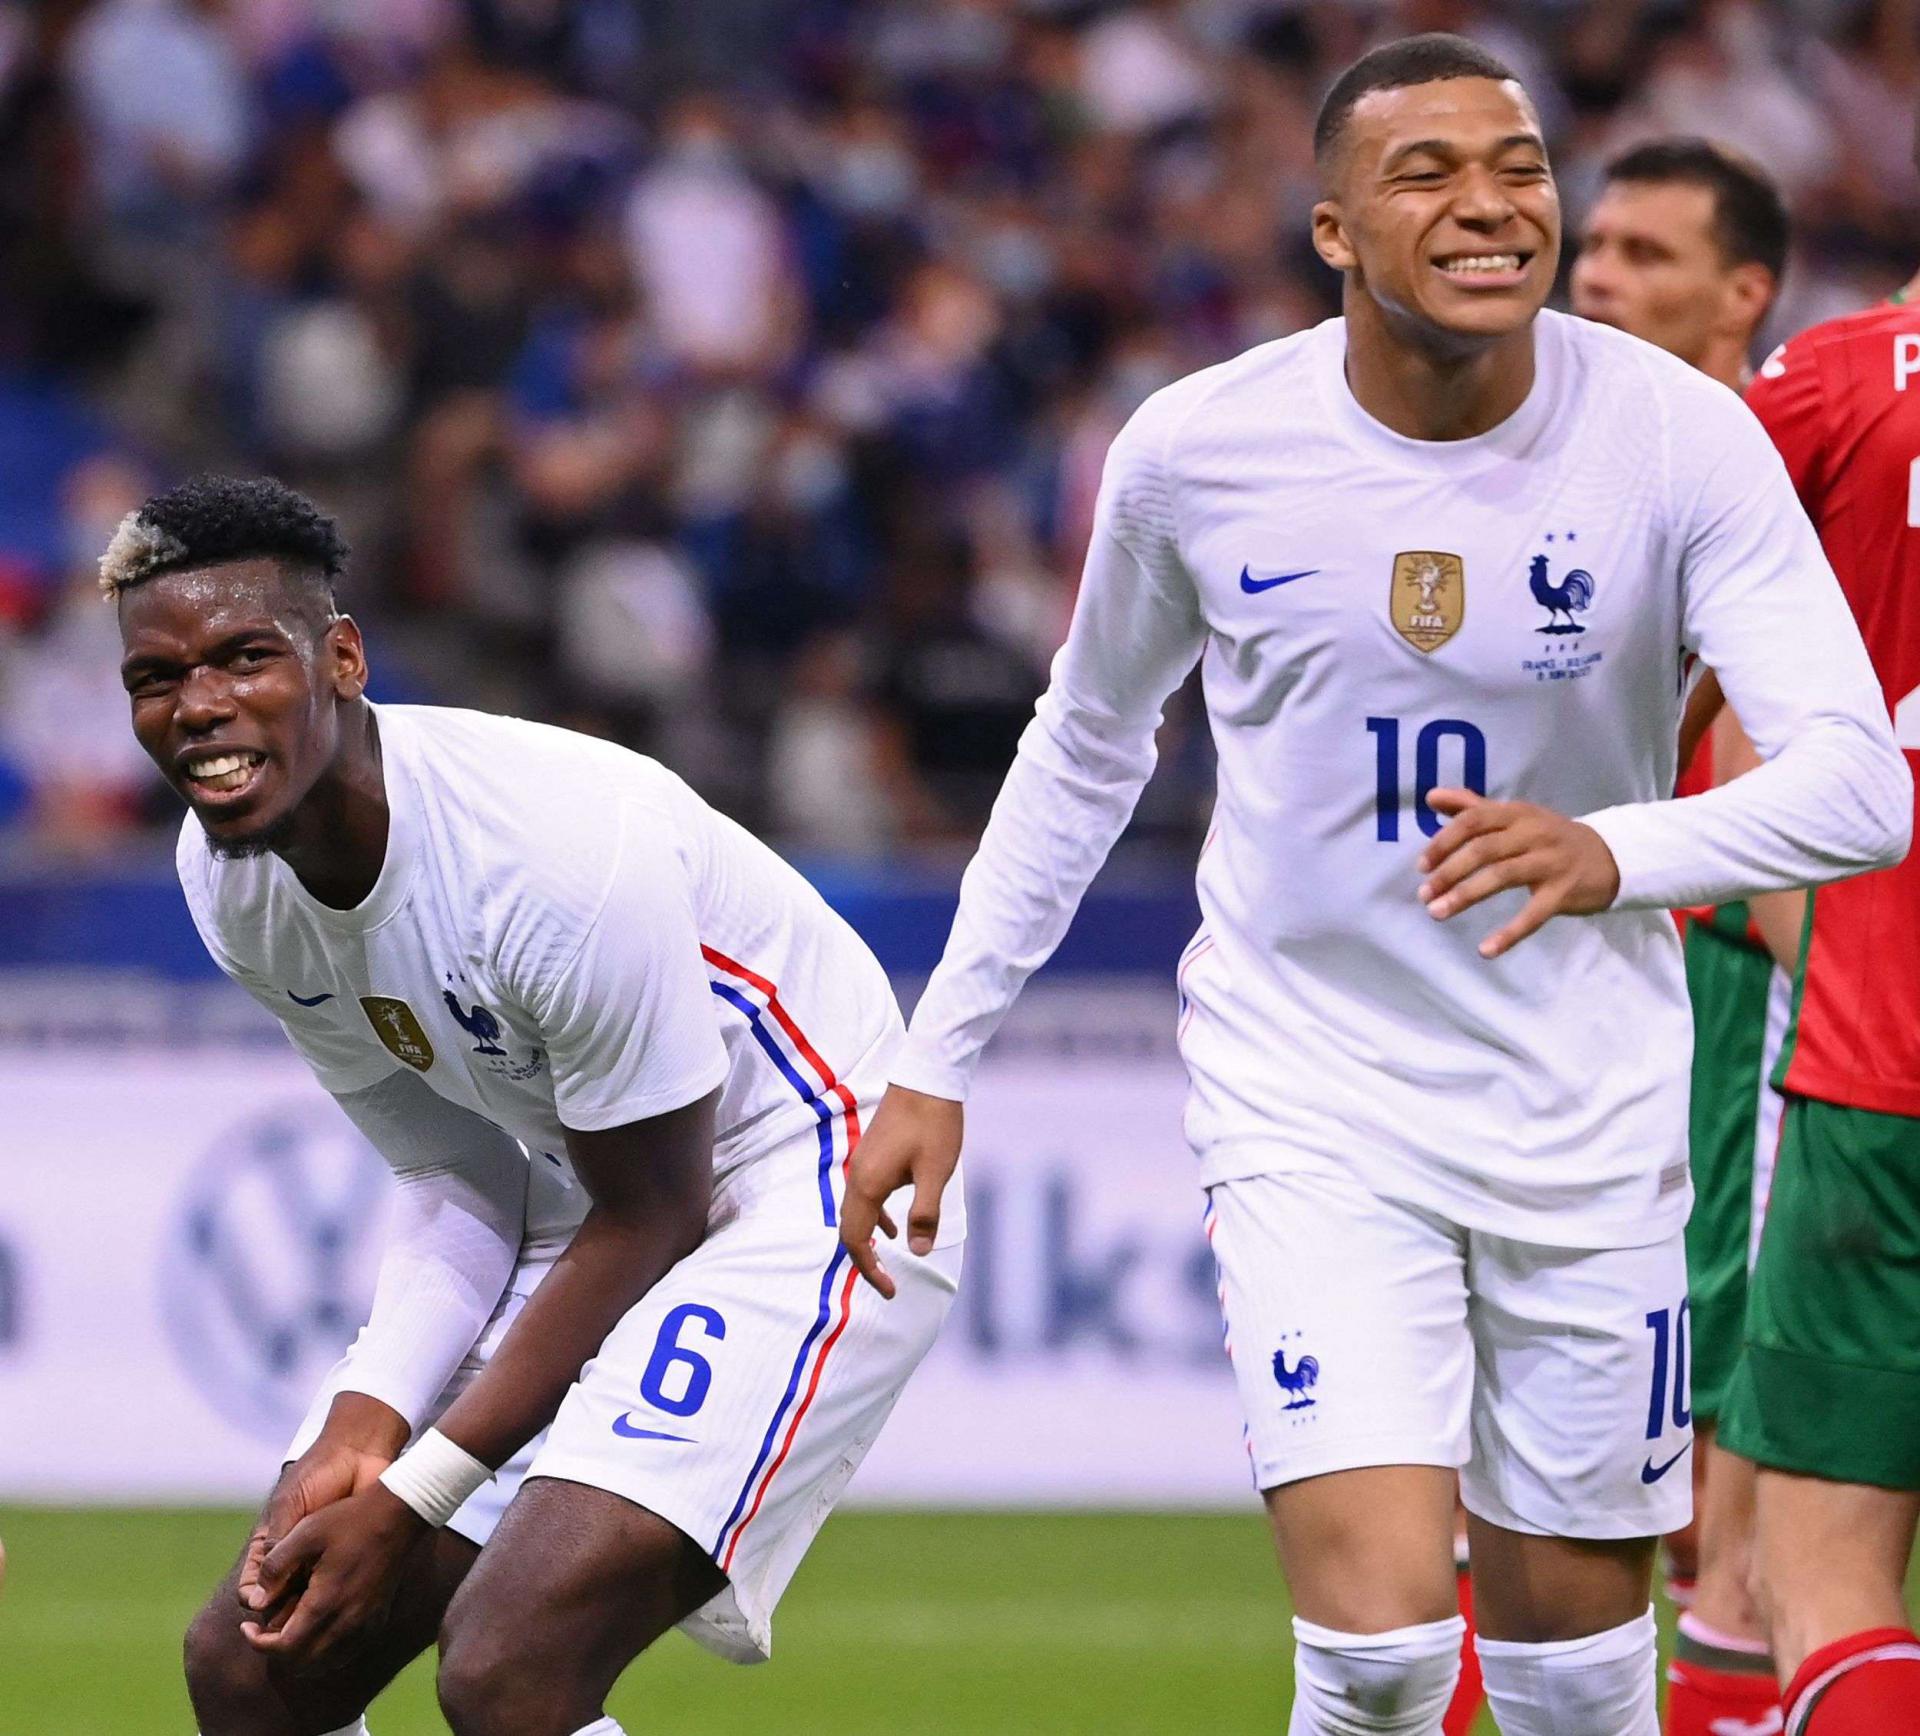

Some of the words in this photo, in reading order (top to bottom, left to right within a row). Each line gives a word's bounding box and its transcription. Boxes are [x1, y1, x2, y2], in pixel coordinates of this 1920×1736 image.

[1409, 615, 1443, 627] FIFA
[1366, 716, 1486, 842] 10
[399, 1043, 423, 1056] FIFA
[640, 1303, 726, 1417] 6
